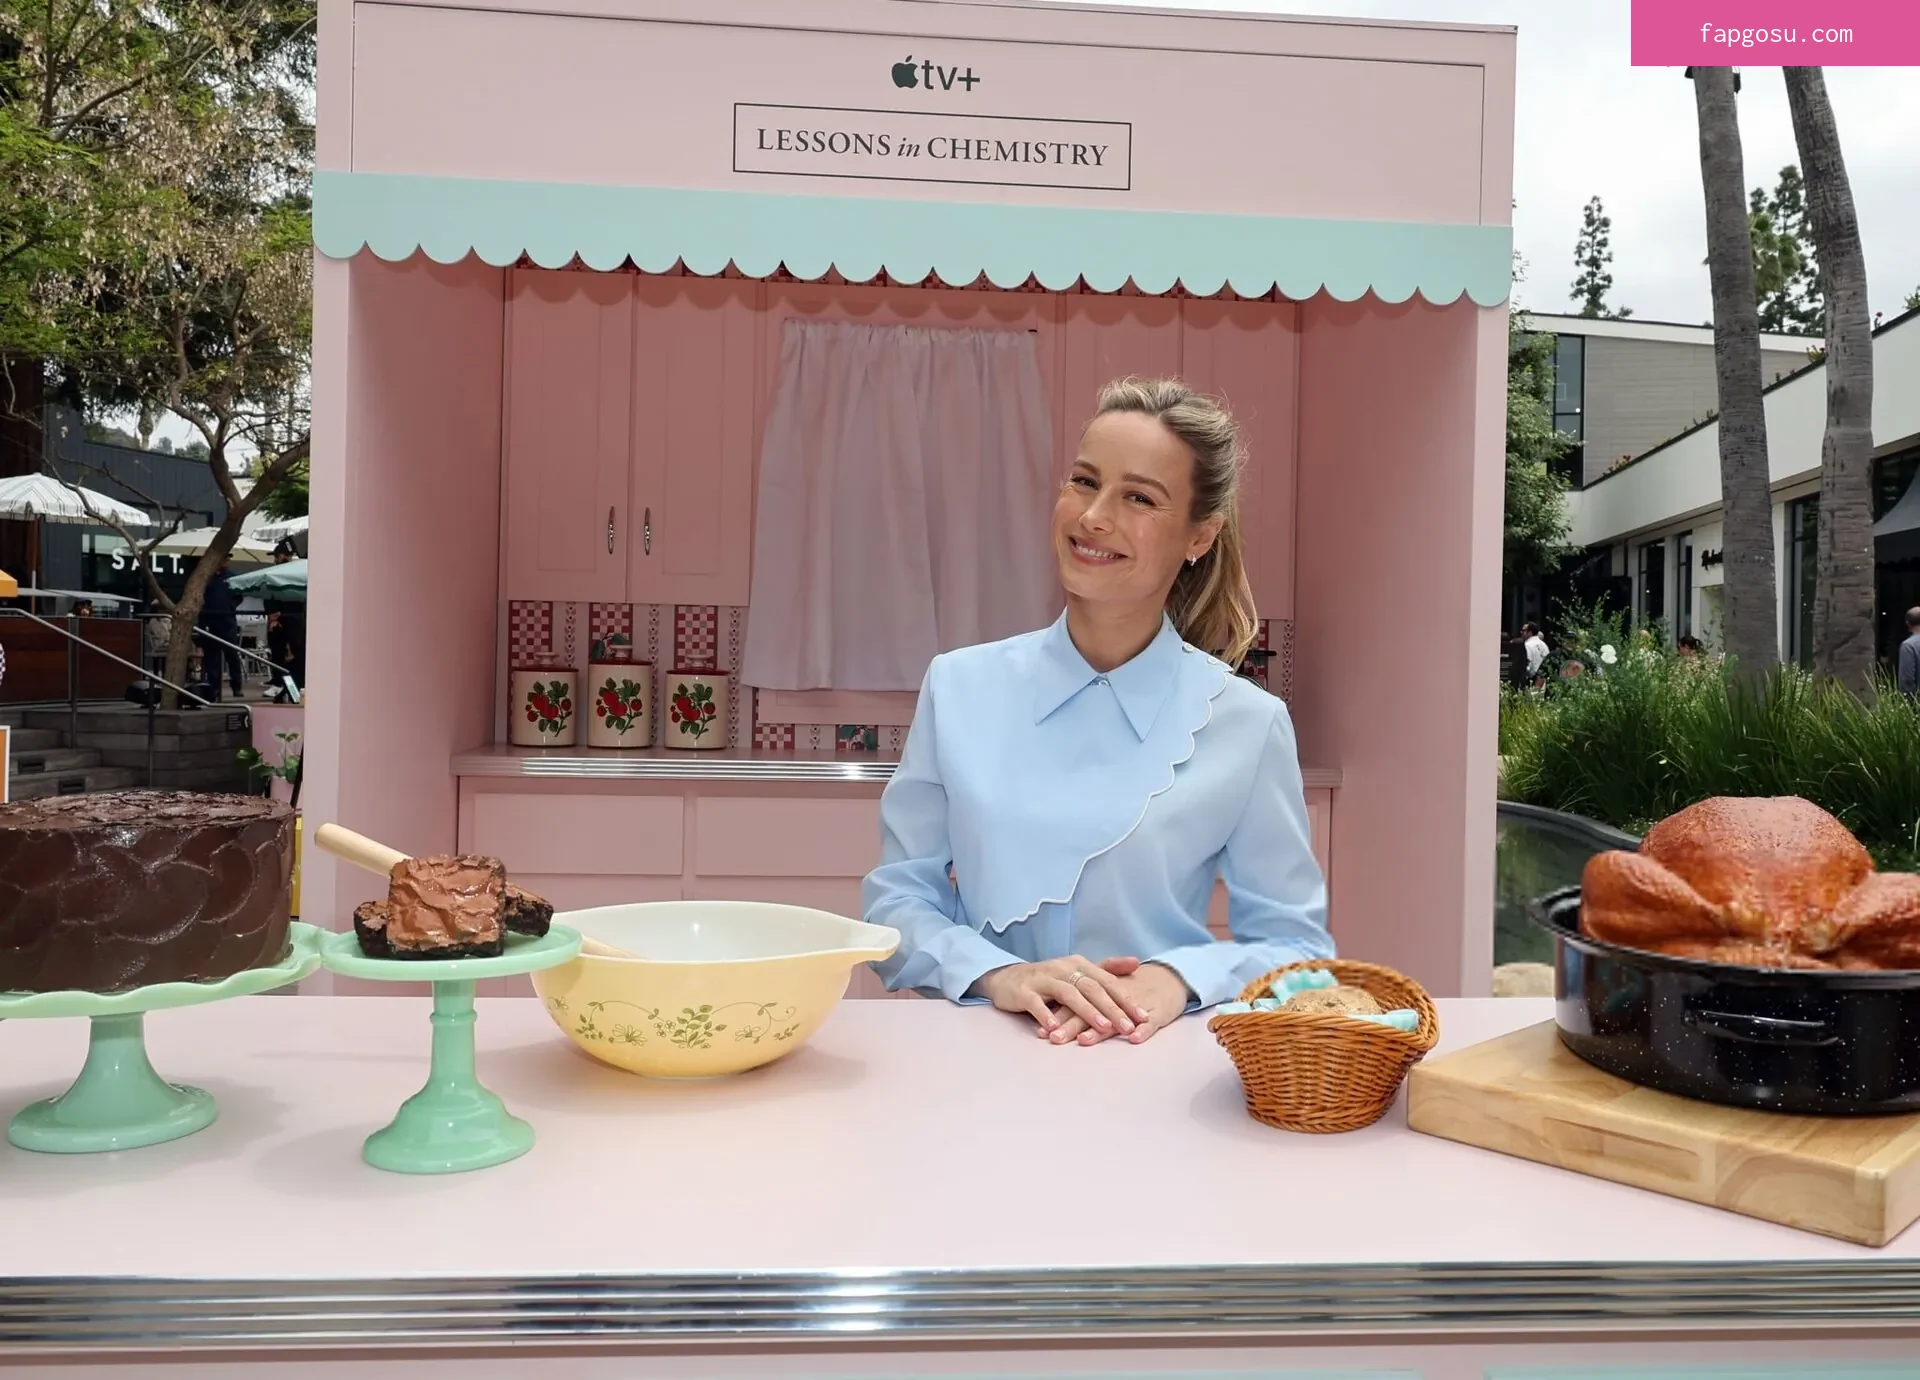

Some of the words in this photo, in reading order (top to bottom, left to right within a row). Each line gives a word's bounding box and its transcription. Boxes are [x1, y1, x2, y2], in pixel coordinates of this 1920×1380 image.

[757, 128, 891, 157] LESSONS
[897, 137, 921, 159] in
[927, 136, 1109, 167] CHEMISTRY
